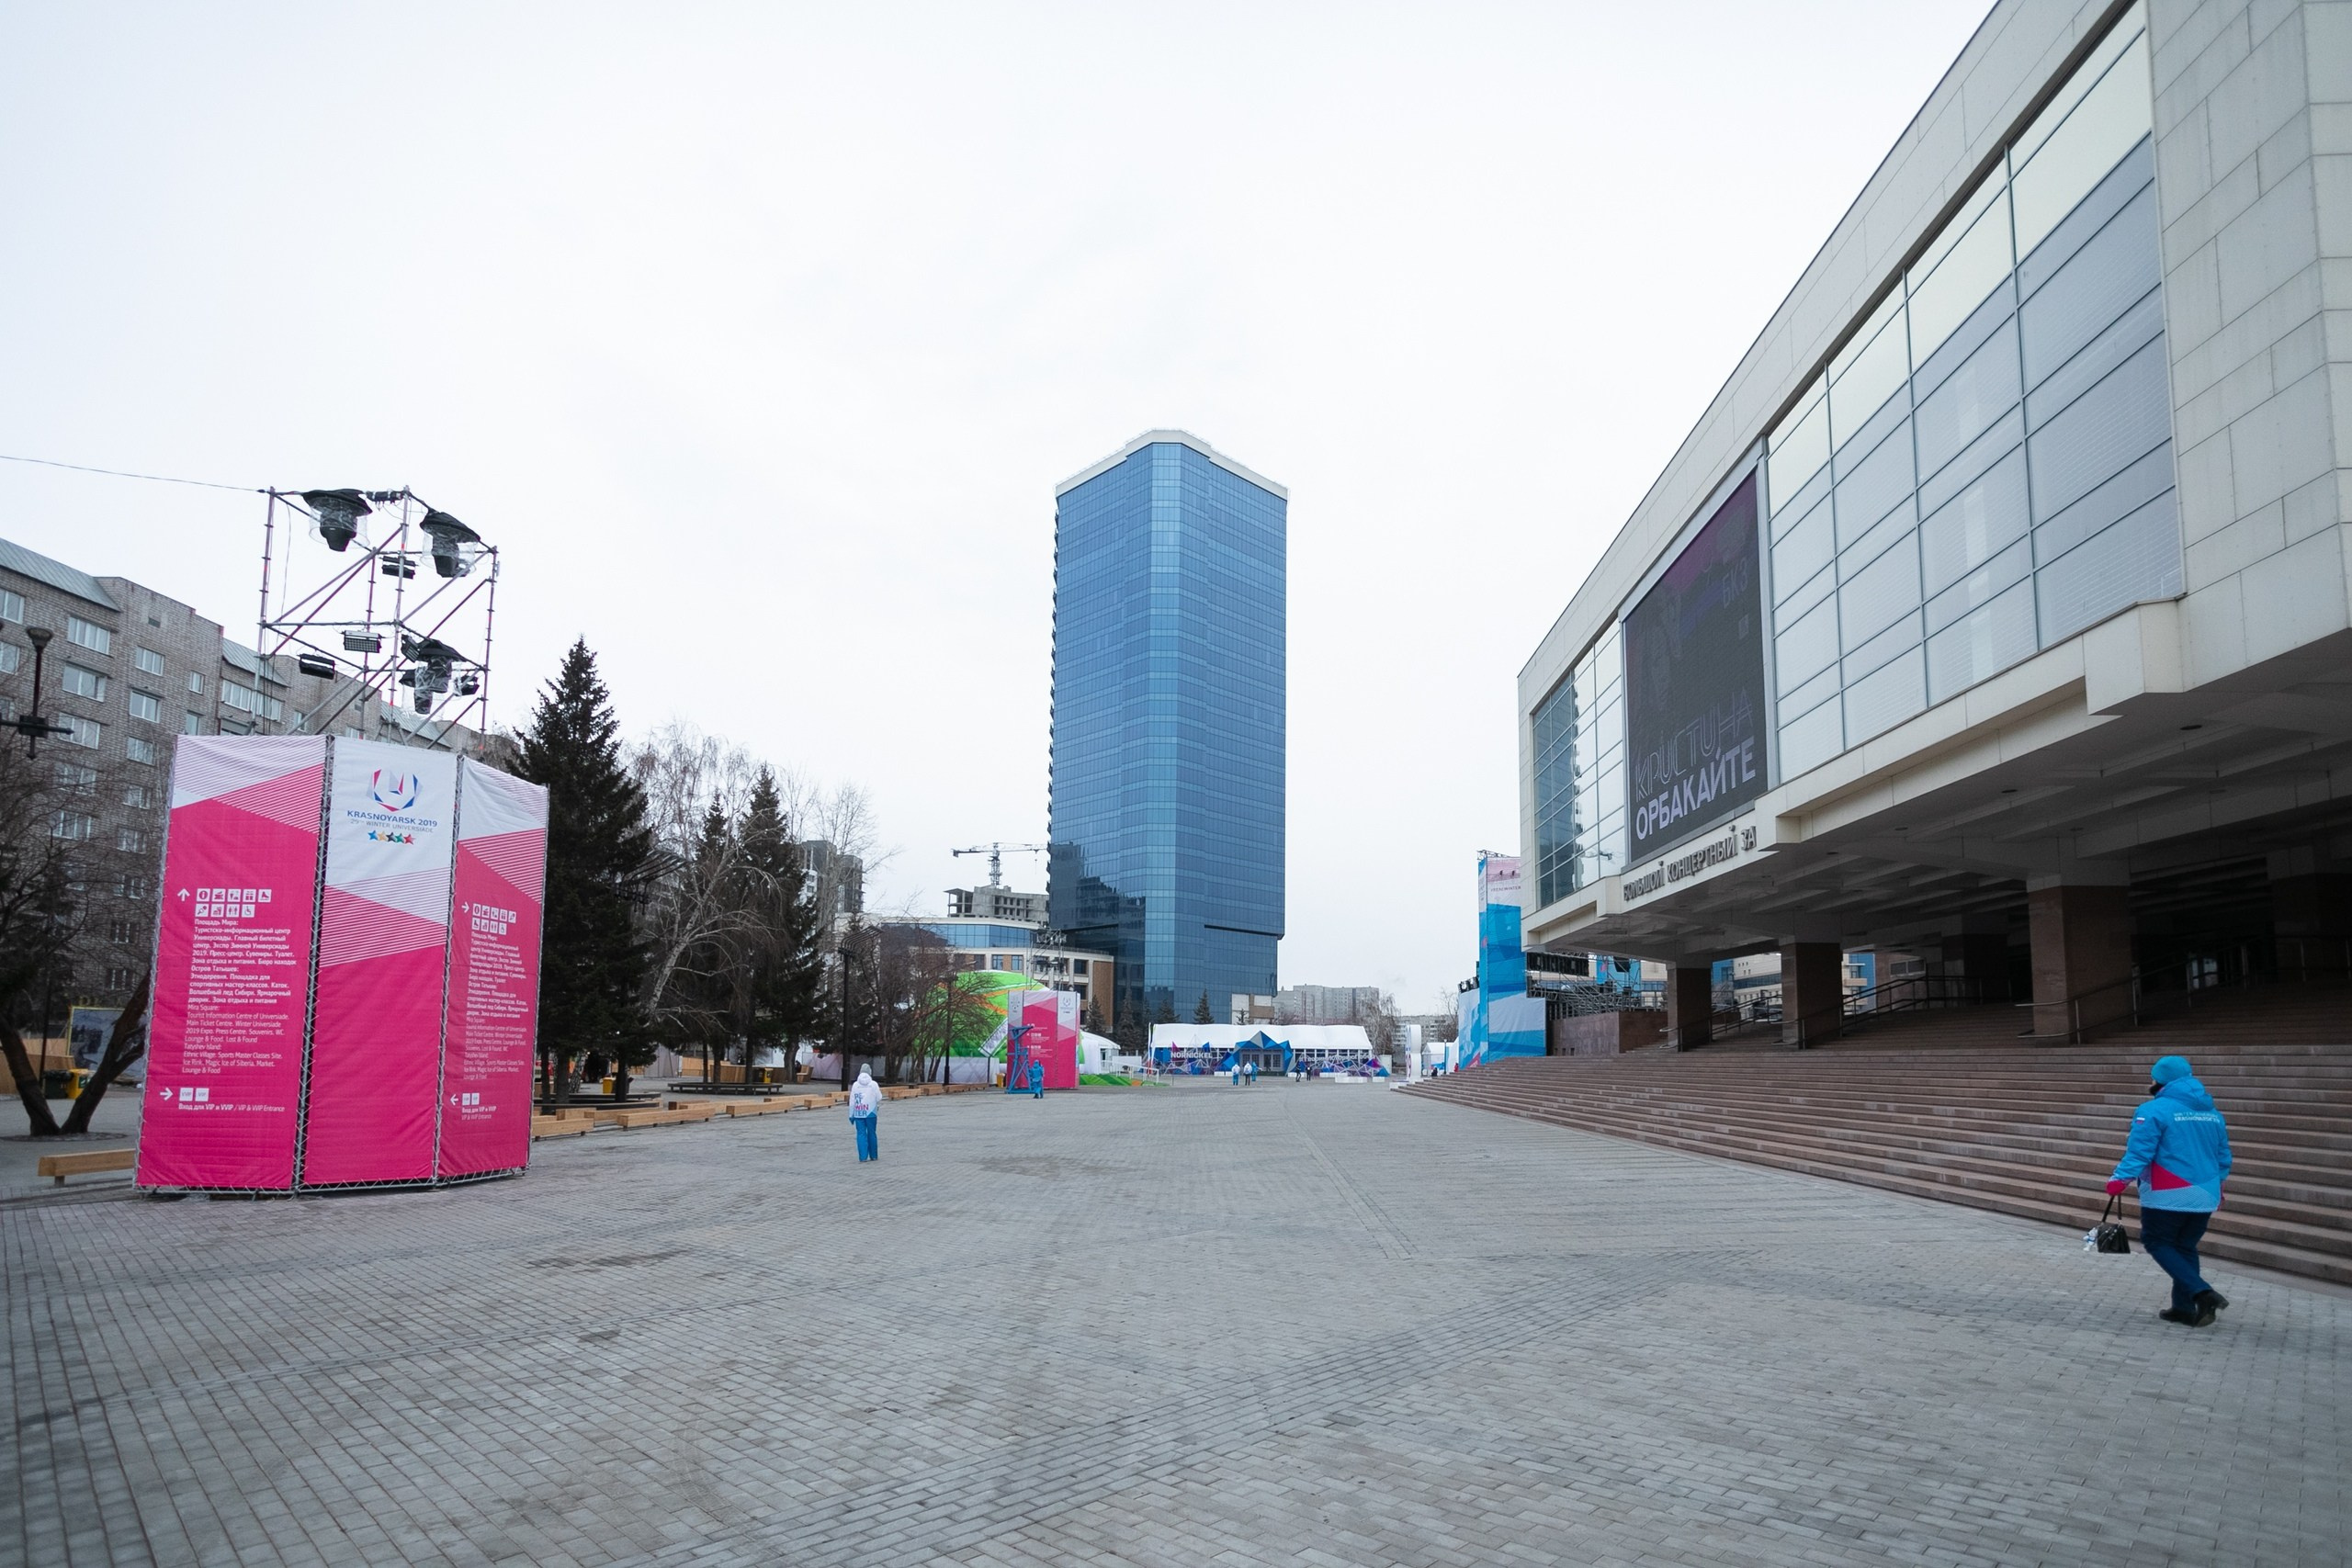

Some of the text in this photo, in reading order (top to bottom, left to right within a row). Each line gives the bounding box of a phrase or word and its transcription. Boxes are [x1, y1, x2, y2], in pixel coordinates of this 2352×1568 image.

[1723, 557, 1748, 610] БКЗ
[1635, 735, 1756, 840] ОРБАКАЙТЕ
[347, 810, 437, 827] KRASNOYARSK 2019
[392, 824, 434, 832] UNIVERSIADE
[1623, 860, 1665, 901] БОЛЬШОЙ
[1667, 824, 1738, 883] КОНЦЕРТНЫЙ
